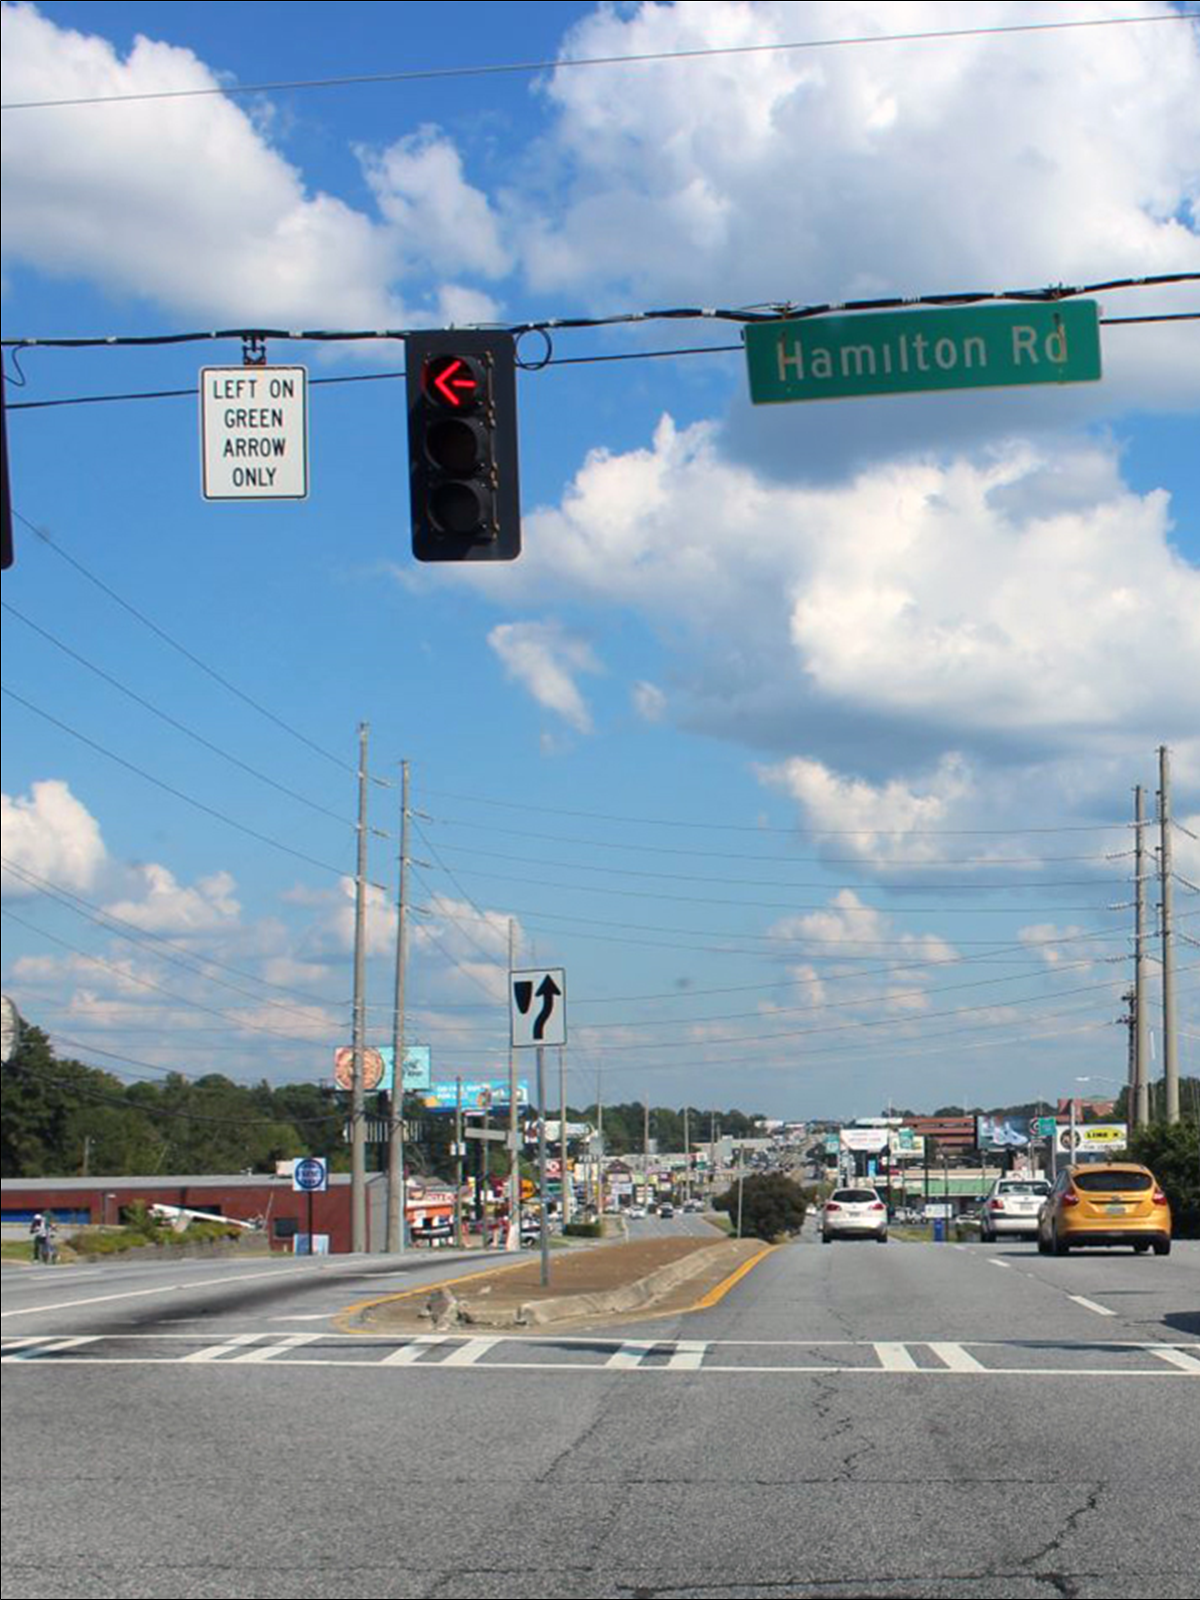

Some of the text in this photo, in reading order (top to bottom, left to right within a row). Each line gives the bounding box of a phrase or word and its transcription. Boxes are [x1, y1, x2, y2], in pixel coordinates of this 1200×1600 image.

[776, 324, 1069, 381] Hamilton Rd
[213, 378, 294, 399] LEFT ON
[224, 408, 283, 429] GREEN
[222, 437, 286, 458] ARROW
[232, 467, 276, 487] ONLY
